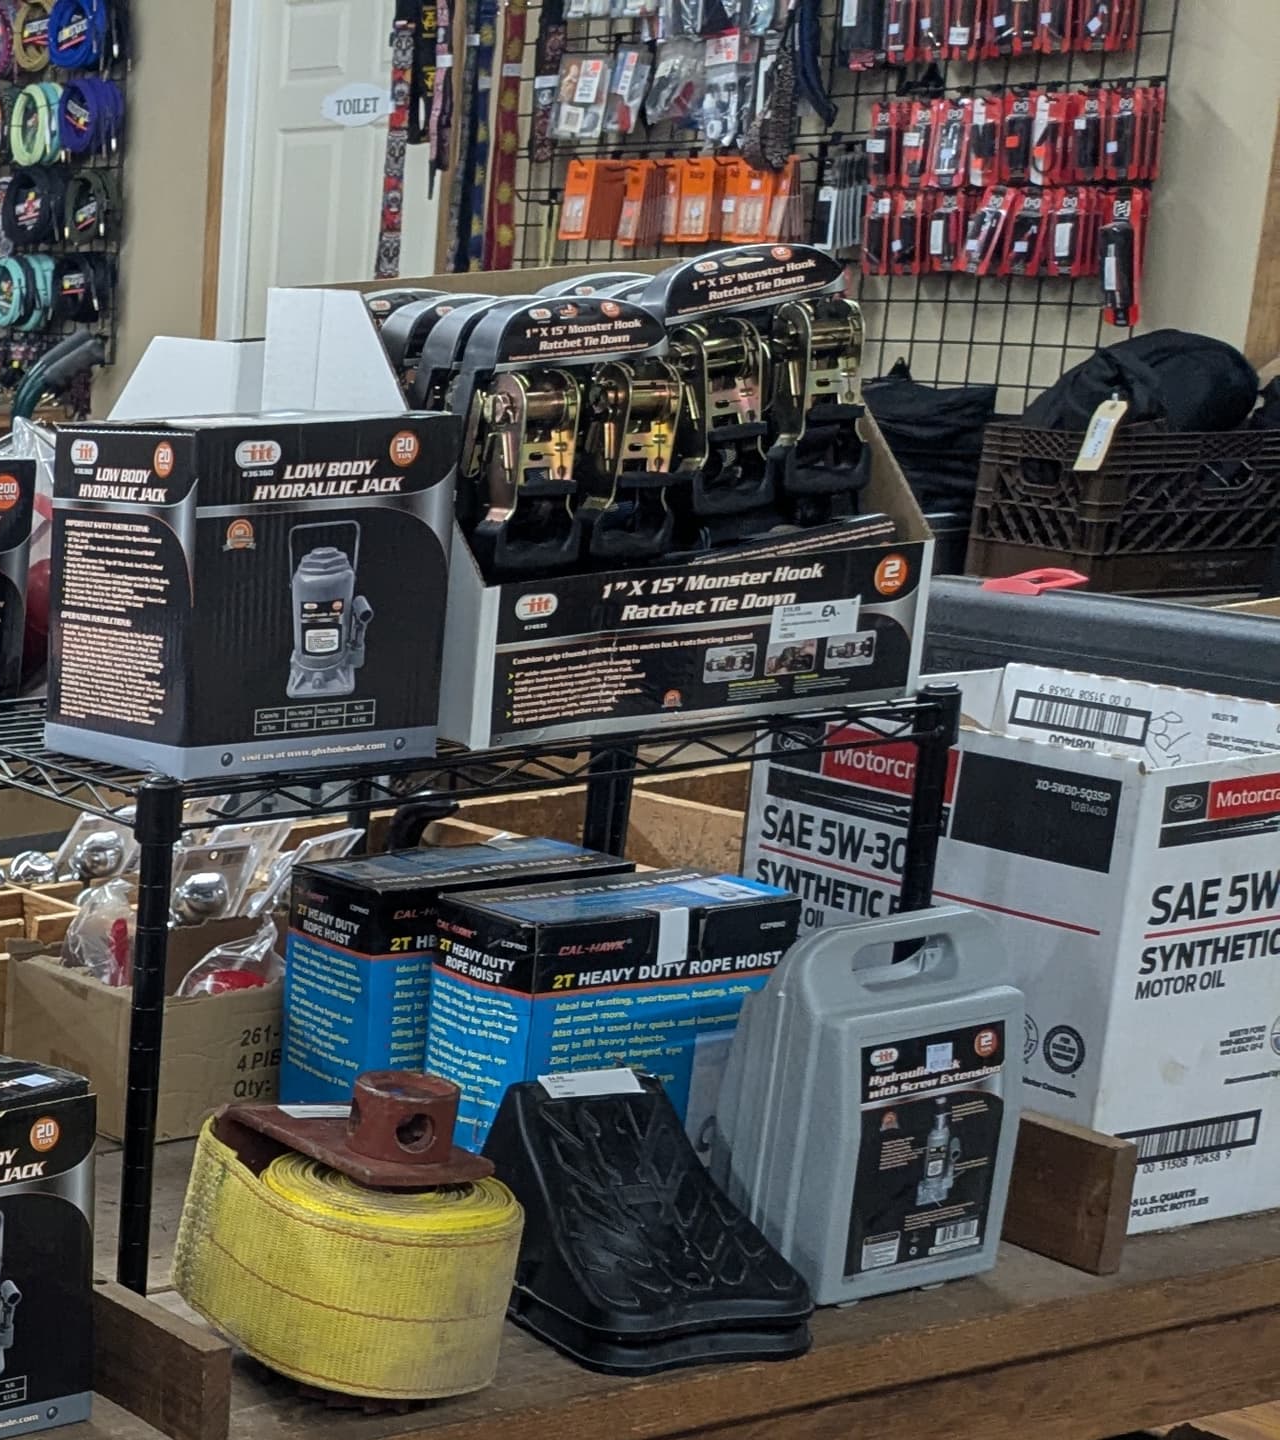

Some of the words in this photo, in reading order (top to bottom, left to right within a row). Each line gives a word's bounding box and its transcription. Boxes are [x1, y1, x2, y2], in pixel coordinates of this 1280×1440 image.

[336, 97, 380, 116] TOILET
[737, 264, 785, 283] Monster
[786, 258, 817, 272] Hook
[708, 285, 755, 301] Ratchet
[756, 280, 772, 293] Tie
[773, 275, 805, 289] Down
[568, 321, 613, 335] Monster
[614, 318, 642, 330] Hook
[539, 337, 582, 352] Ratchet
[584, 336, 600, 347] Tie
[600, 333, 630, 346] Down
[397, 437, 414, 453] 20
[95, 467, 119, 483] LOW
[120, 468, 151, 484] BODY
[283, 463, 326, 481] LOW
[326, 459, 378, 478] BODY
[78, 483, 138, 501] HYDRAULIC
[137, 487, 168, 503] JACK
[253, 480, 359, 501] HYDRAULIC
[358, 476, 405, 494] JACK
[685, 568, 771, 592] Monster
[774, 563, 824, 584] Hook
[884, 559, 900, 578] 2
[621, 599, 708, 621] Ratchet
[710, 594, 740, 614] Tie
[833, 749, 915, 780] Motorcr
[1216, 787, 1280, 809] Motorcra
[761, 804, 815, 850] SAE
[756, 858, 884, 918] SYNTHETIC
[1147, 878, 1223, 926] SAE
[1226, 870, 1280, 915] 5W
[391, 936, 413, 952] 2T
[452, 942, 482, 966] HEAVY
[482, 952, 517, 974] DUTY
[444, 955, 468, 975] ROPE
[469, 964, 504, 985] HOIST
[552, 973, 577, 990] 2T
[578, 967, 636, 987] HEAVY
[638, 961, 687, 981] DUTY
[688, 955, 734, 975] ROPE
[735, 950, 784, 971] HOIST
[1135, 974, 1197, 1000] MOTOR
[1199, 970, 1226, 991] OIL
[240, 1026, 281, 1048] 261-
[233, 1079, 272, 1098] Qty:
[868, 1086, 899, 1100] with
[900, 1078, 938, 1094] Screw
[940, 1064, 1002, 1084] Extension
[37, 1122, 55, 1138] 20
[1160, 1188, 1197, 1203] QUARTS
[1131, 1203, 1169, 1218] PLASTIC
[1169, 1196, 1210, 1212] BOTTLES
